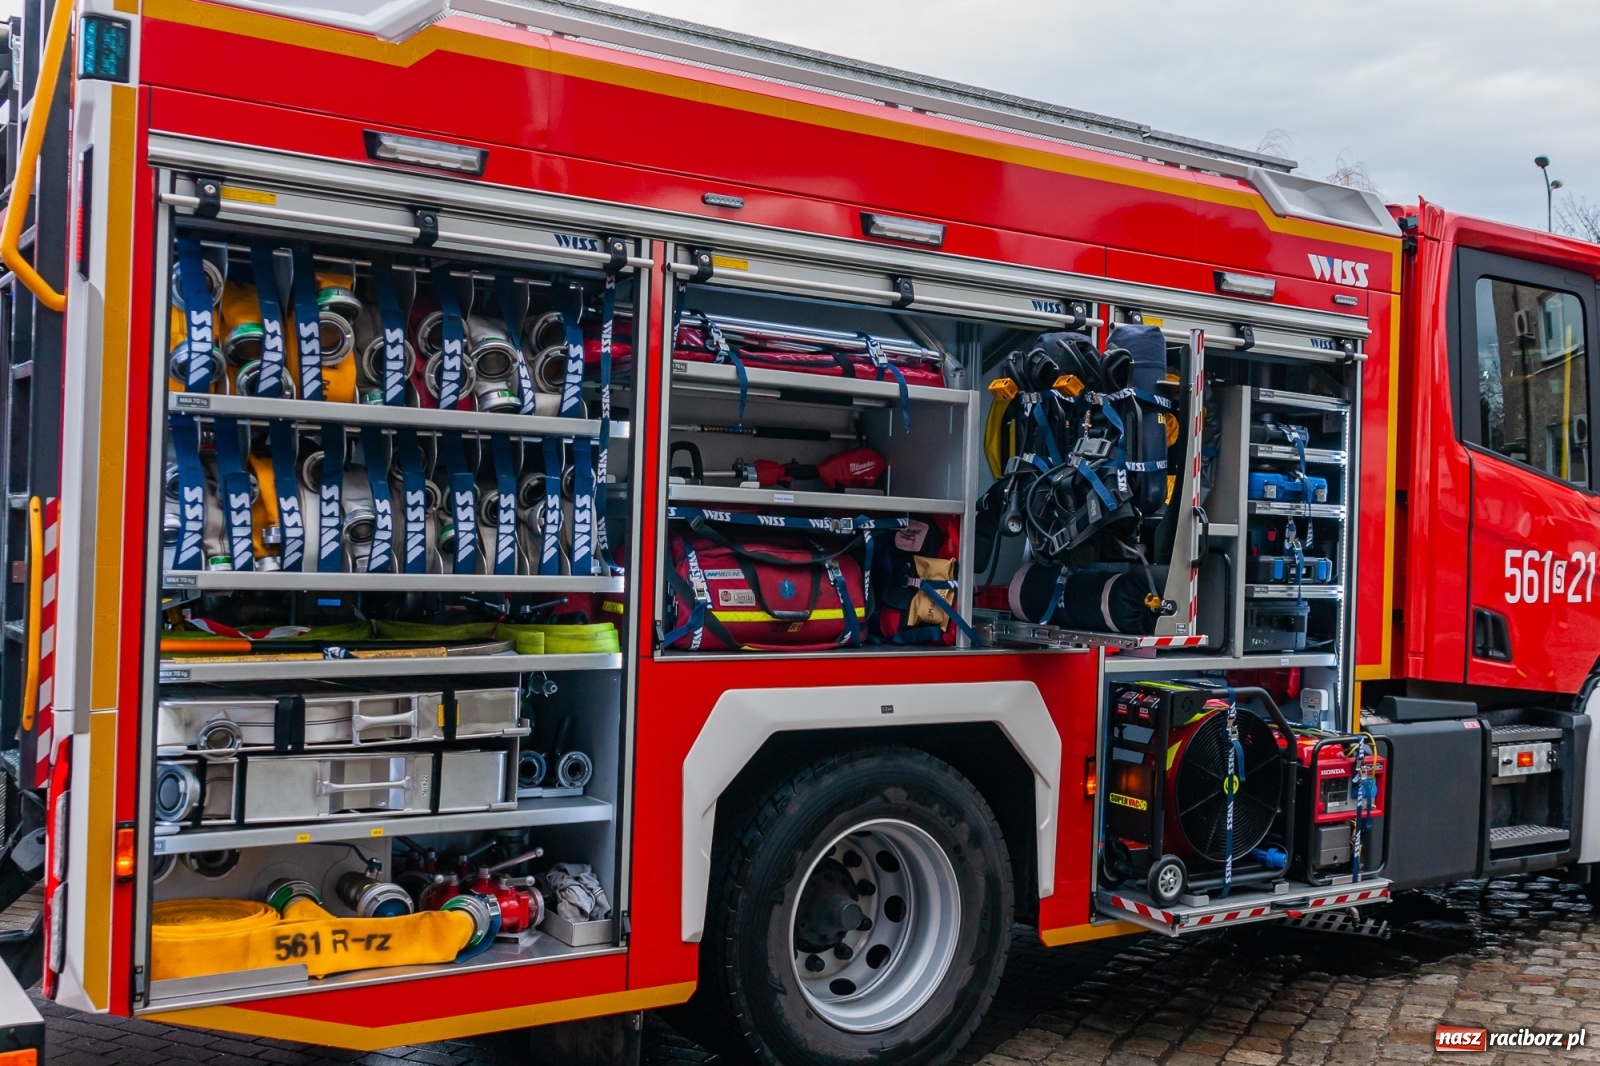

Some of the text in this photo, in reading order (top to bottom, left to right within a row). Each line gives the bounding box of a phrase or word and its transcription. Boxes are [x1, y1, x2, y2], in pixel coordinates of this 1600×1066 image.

[554, 234, 598, 252] WISS
[1307, 253, 1369, 288] WISS
[602, 319, 612, 354] WISS
[1032, 300, 1062, 314] WISS
[188, 310, 212, 386] WISS
[257, 318, 283, 394] WISS
[299, 321, 323, 399] WISS
[385, 328, 404, 403] WISS
[438, 339, 461, 410] WISS
[561, 344, 584, 413] WISS
[1310, 338, 1334, 350] WISS
[601, 384, 610, 419] WISS
[1107, 388, 1136, 401] WISS
[178, 486, 203, 564] WISS
[230, 492, 252, 570] WISS
[280, 496, 304, 570] WISS
[320, 484, 340, 560] WISS
[406, 490, 424, 564] WISS
[456, 490, 476, 562] WISS
[498, 493, 515, 564] WISS
[542, 494, 560, 564] WISS
[574, 494, 592, 562] WISS
[598, 448, 608, 550] WISS WISS
[702, 510, 732, 522] WISS
[758, 516, 786, 526] WISS
[368, 499, 392, 571] WISS
[180, 576, 187, 584] 70
[1320, 768, 1346, 776] HONDA
[275, 928, 392, 961] 561 R-rz
